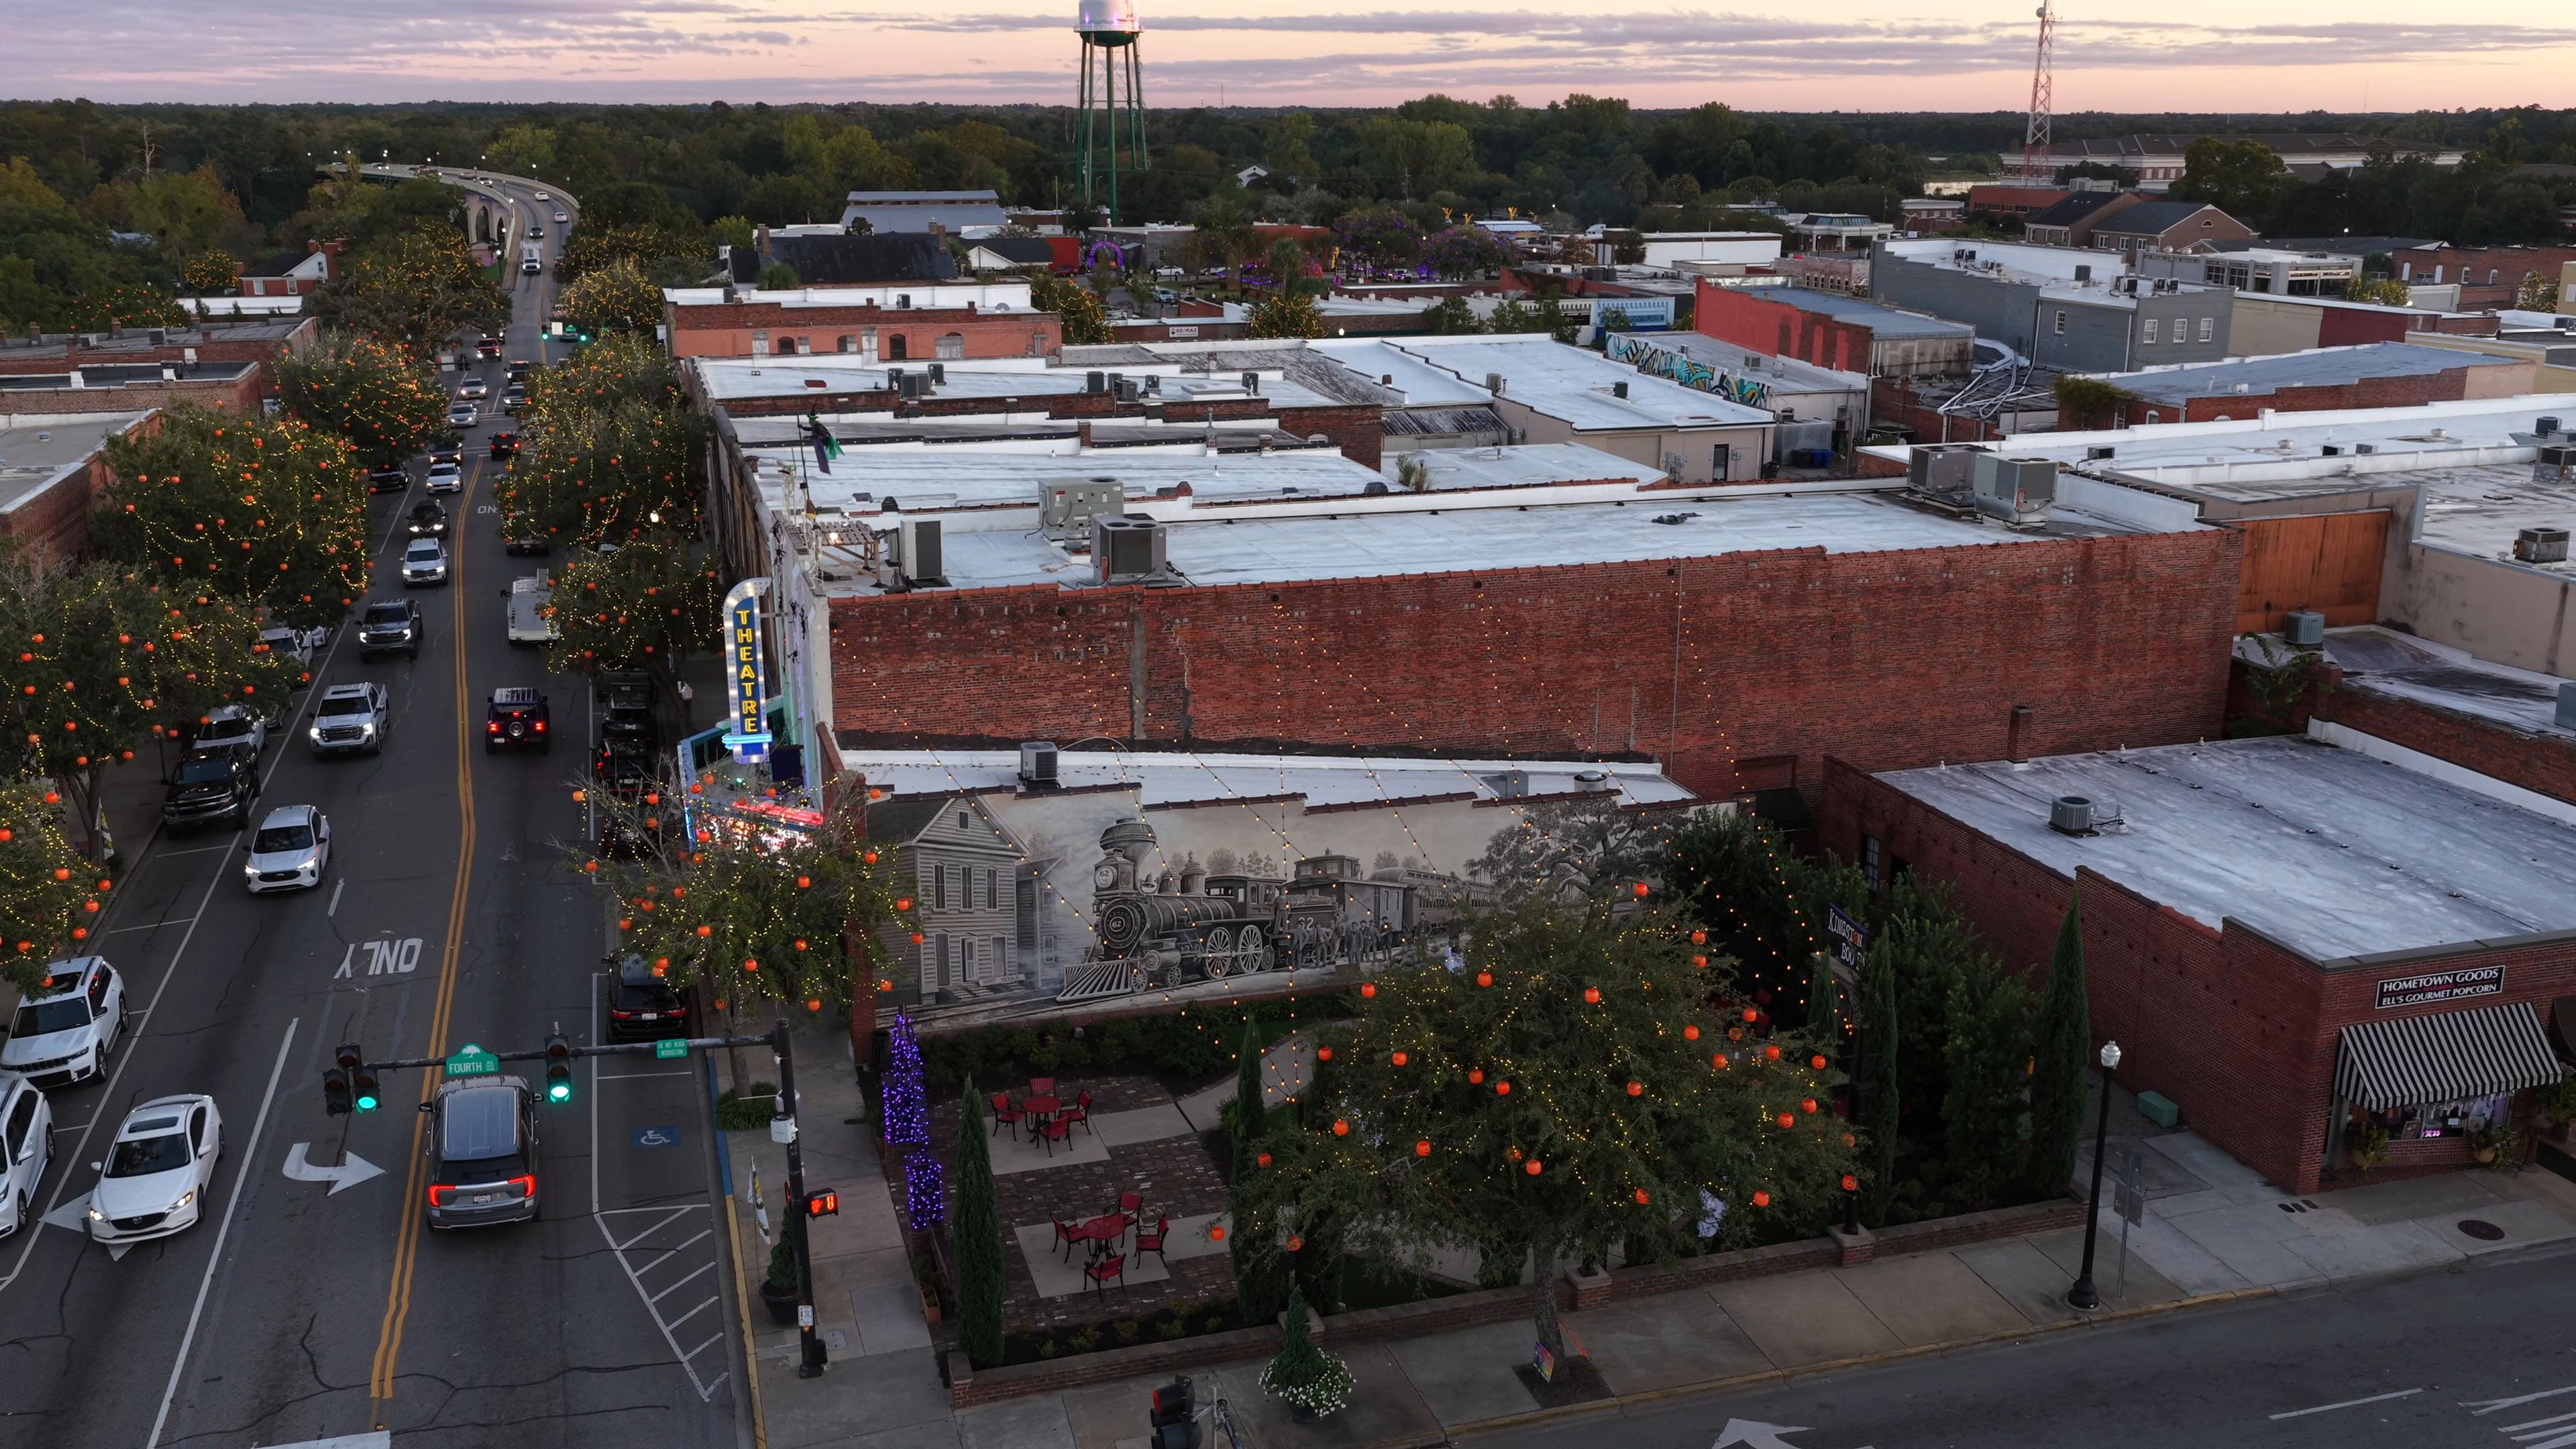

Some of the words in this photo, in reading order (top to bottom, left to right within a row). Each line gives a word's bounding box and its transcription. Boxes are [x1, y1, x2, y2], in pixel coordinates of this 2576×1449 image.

[736, 610, 758, 733] THEATRE
[1828, 908, 1864, 948] KINGSTON
[333, 938, 423, 979] ONLY
[1841, 943, 1855, 965] BOO
[2383, 974, 2454, 992] HOMETOWN
[2455, 968, 2500, 983] GOODS
[2382, 995, 2404, 1006] ELL'S
[2406, 989, 2451, 1003] GOURMET
[2452, 983, 2498, 996] POPCORN
[449, 1062, 482, 1073] FOURTH
